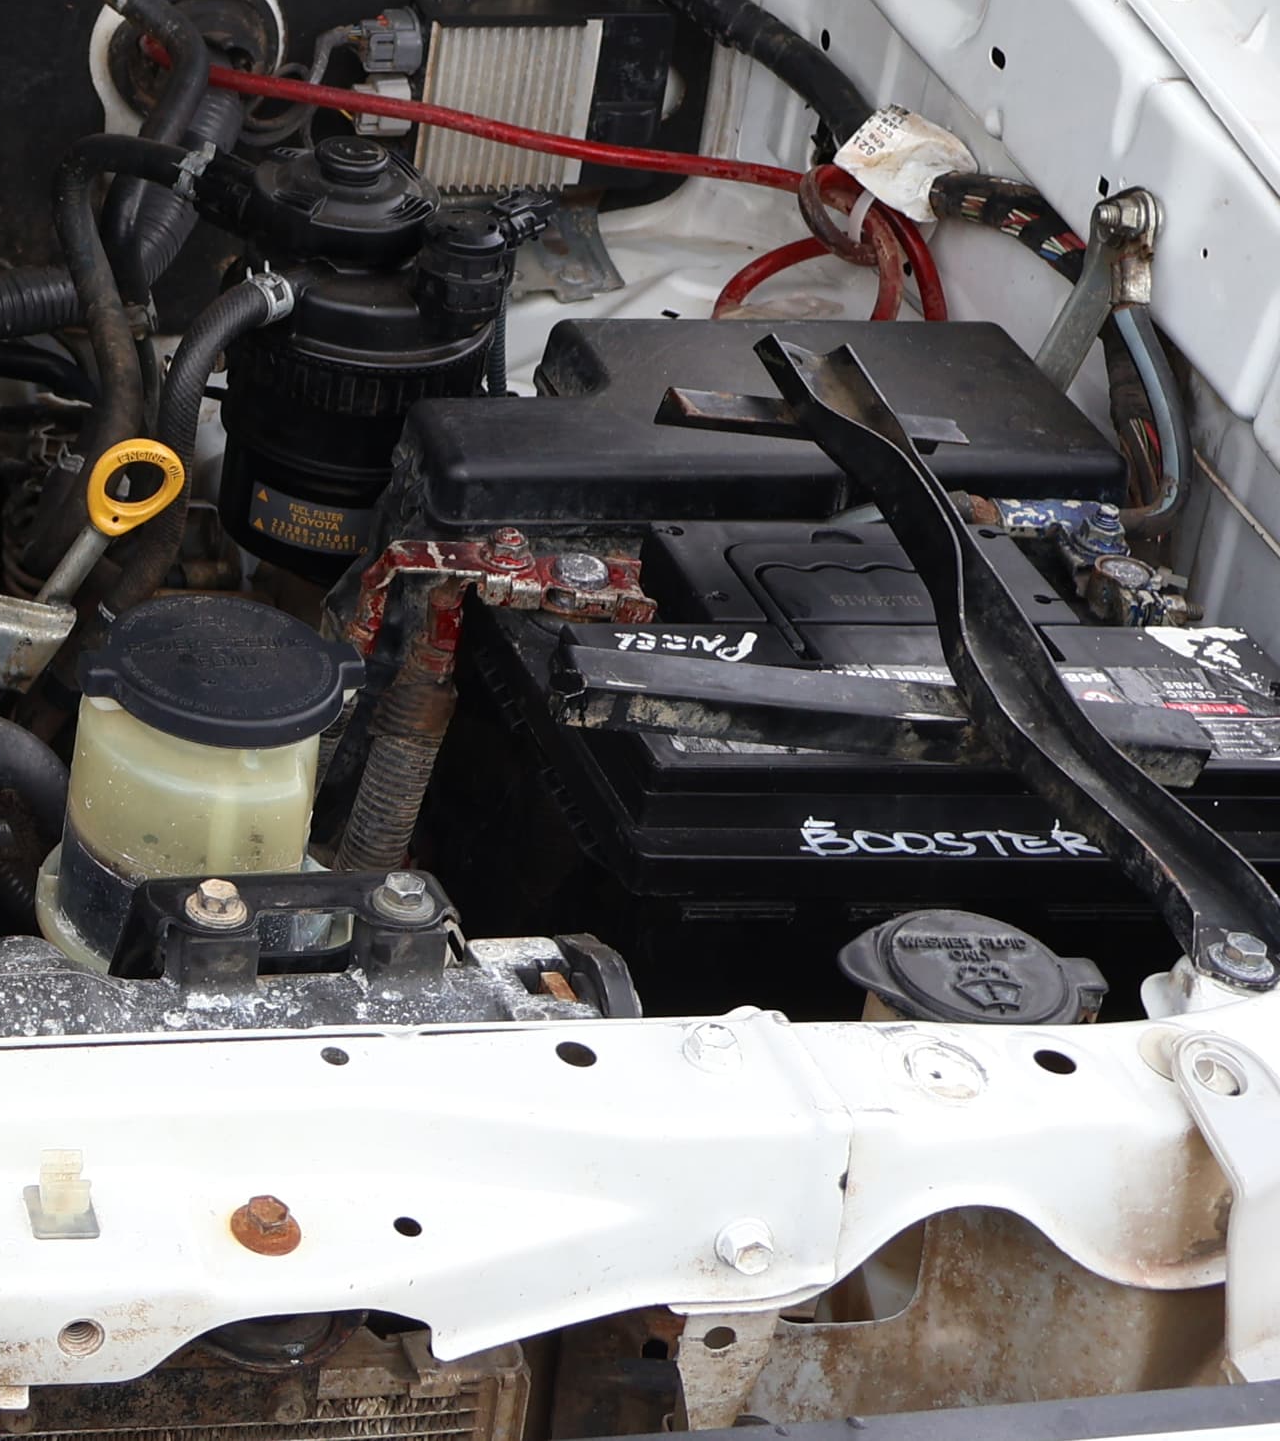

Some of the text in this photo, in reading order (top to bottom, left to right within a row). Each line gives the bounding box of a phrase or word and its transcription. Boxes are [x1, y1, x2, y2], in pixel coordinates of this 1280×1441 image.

[117, 450, 181, 481] ENGINE OIL
[288, 503, 345, 523] FUEL FILTER
[290, 513, 340, 532] TOYOTA
[1162, 681, 1204, 690] SABS
[800, 815, 1103, 856] BOOSTER
[898, 935, 1028, 951] WASHER FLUID
[948, 949, 991, 962] ONLY
